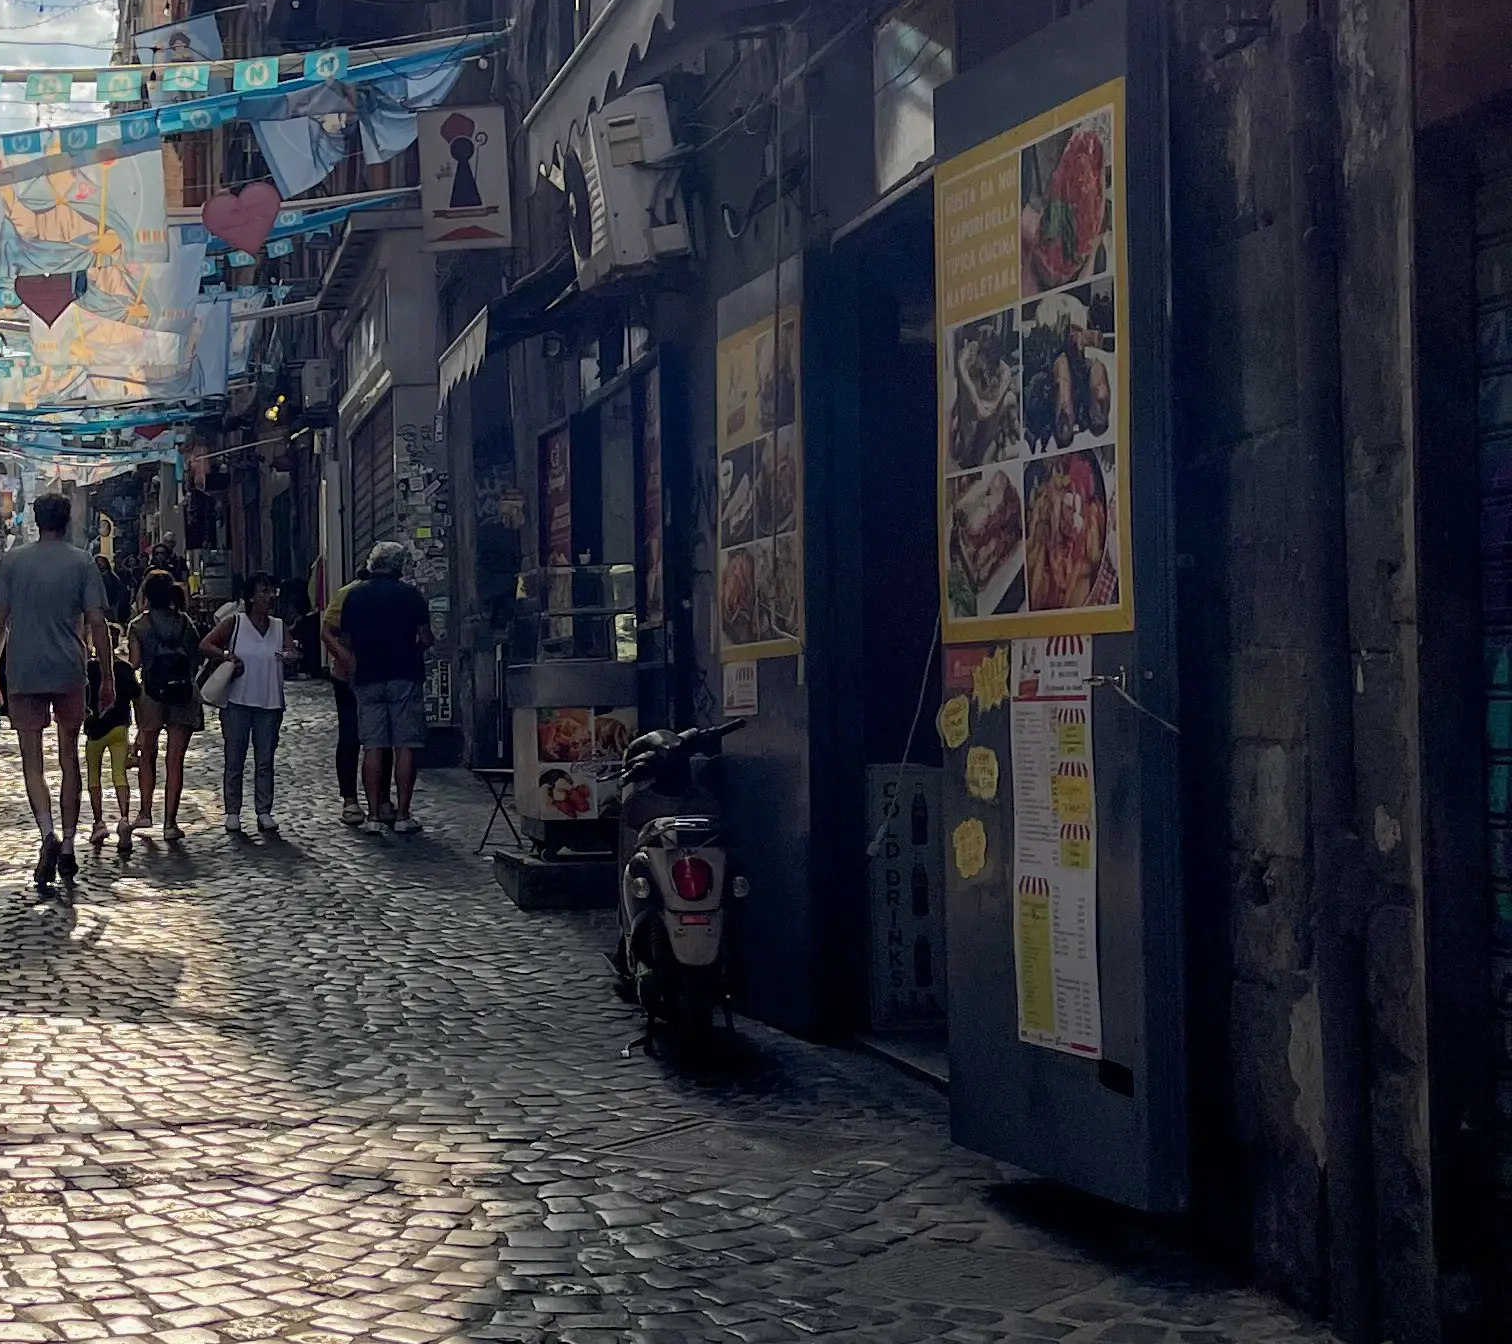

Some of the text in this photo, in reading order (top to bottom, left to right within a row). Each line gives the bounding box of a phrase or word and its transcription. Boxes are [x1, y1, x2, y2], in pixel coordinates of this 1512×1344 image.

[250, 64, 264, 80] N
[321, 56, 335, 72] N
[114, 79, 128, 92] N
[980, 177, 994, 202] DA
[998, 166, 1017, 192] NOI
[950, 213, 984, 246] SAPORI
[985, 201, 1016, 231] DELLA
[946, 233, 1017, 277] TIPICA CUCINA
[946, 265, 1018, 309] NAPOLETANA
[882, 781, 903, 988] COLD DRINKS
